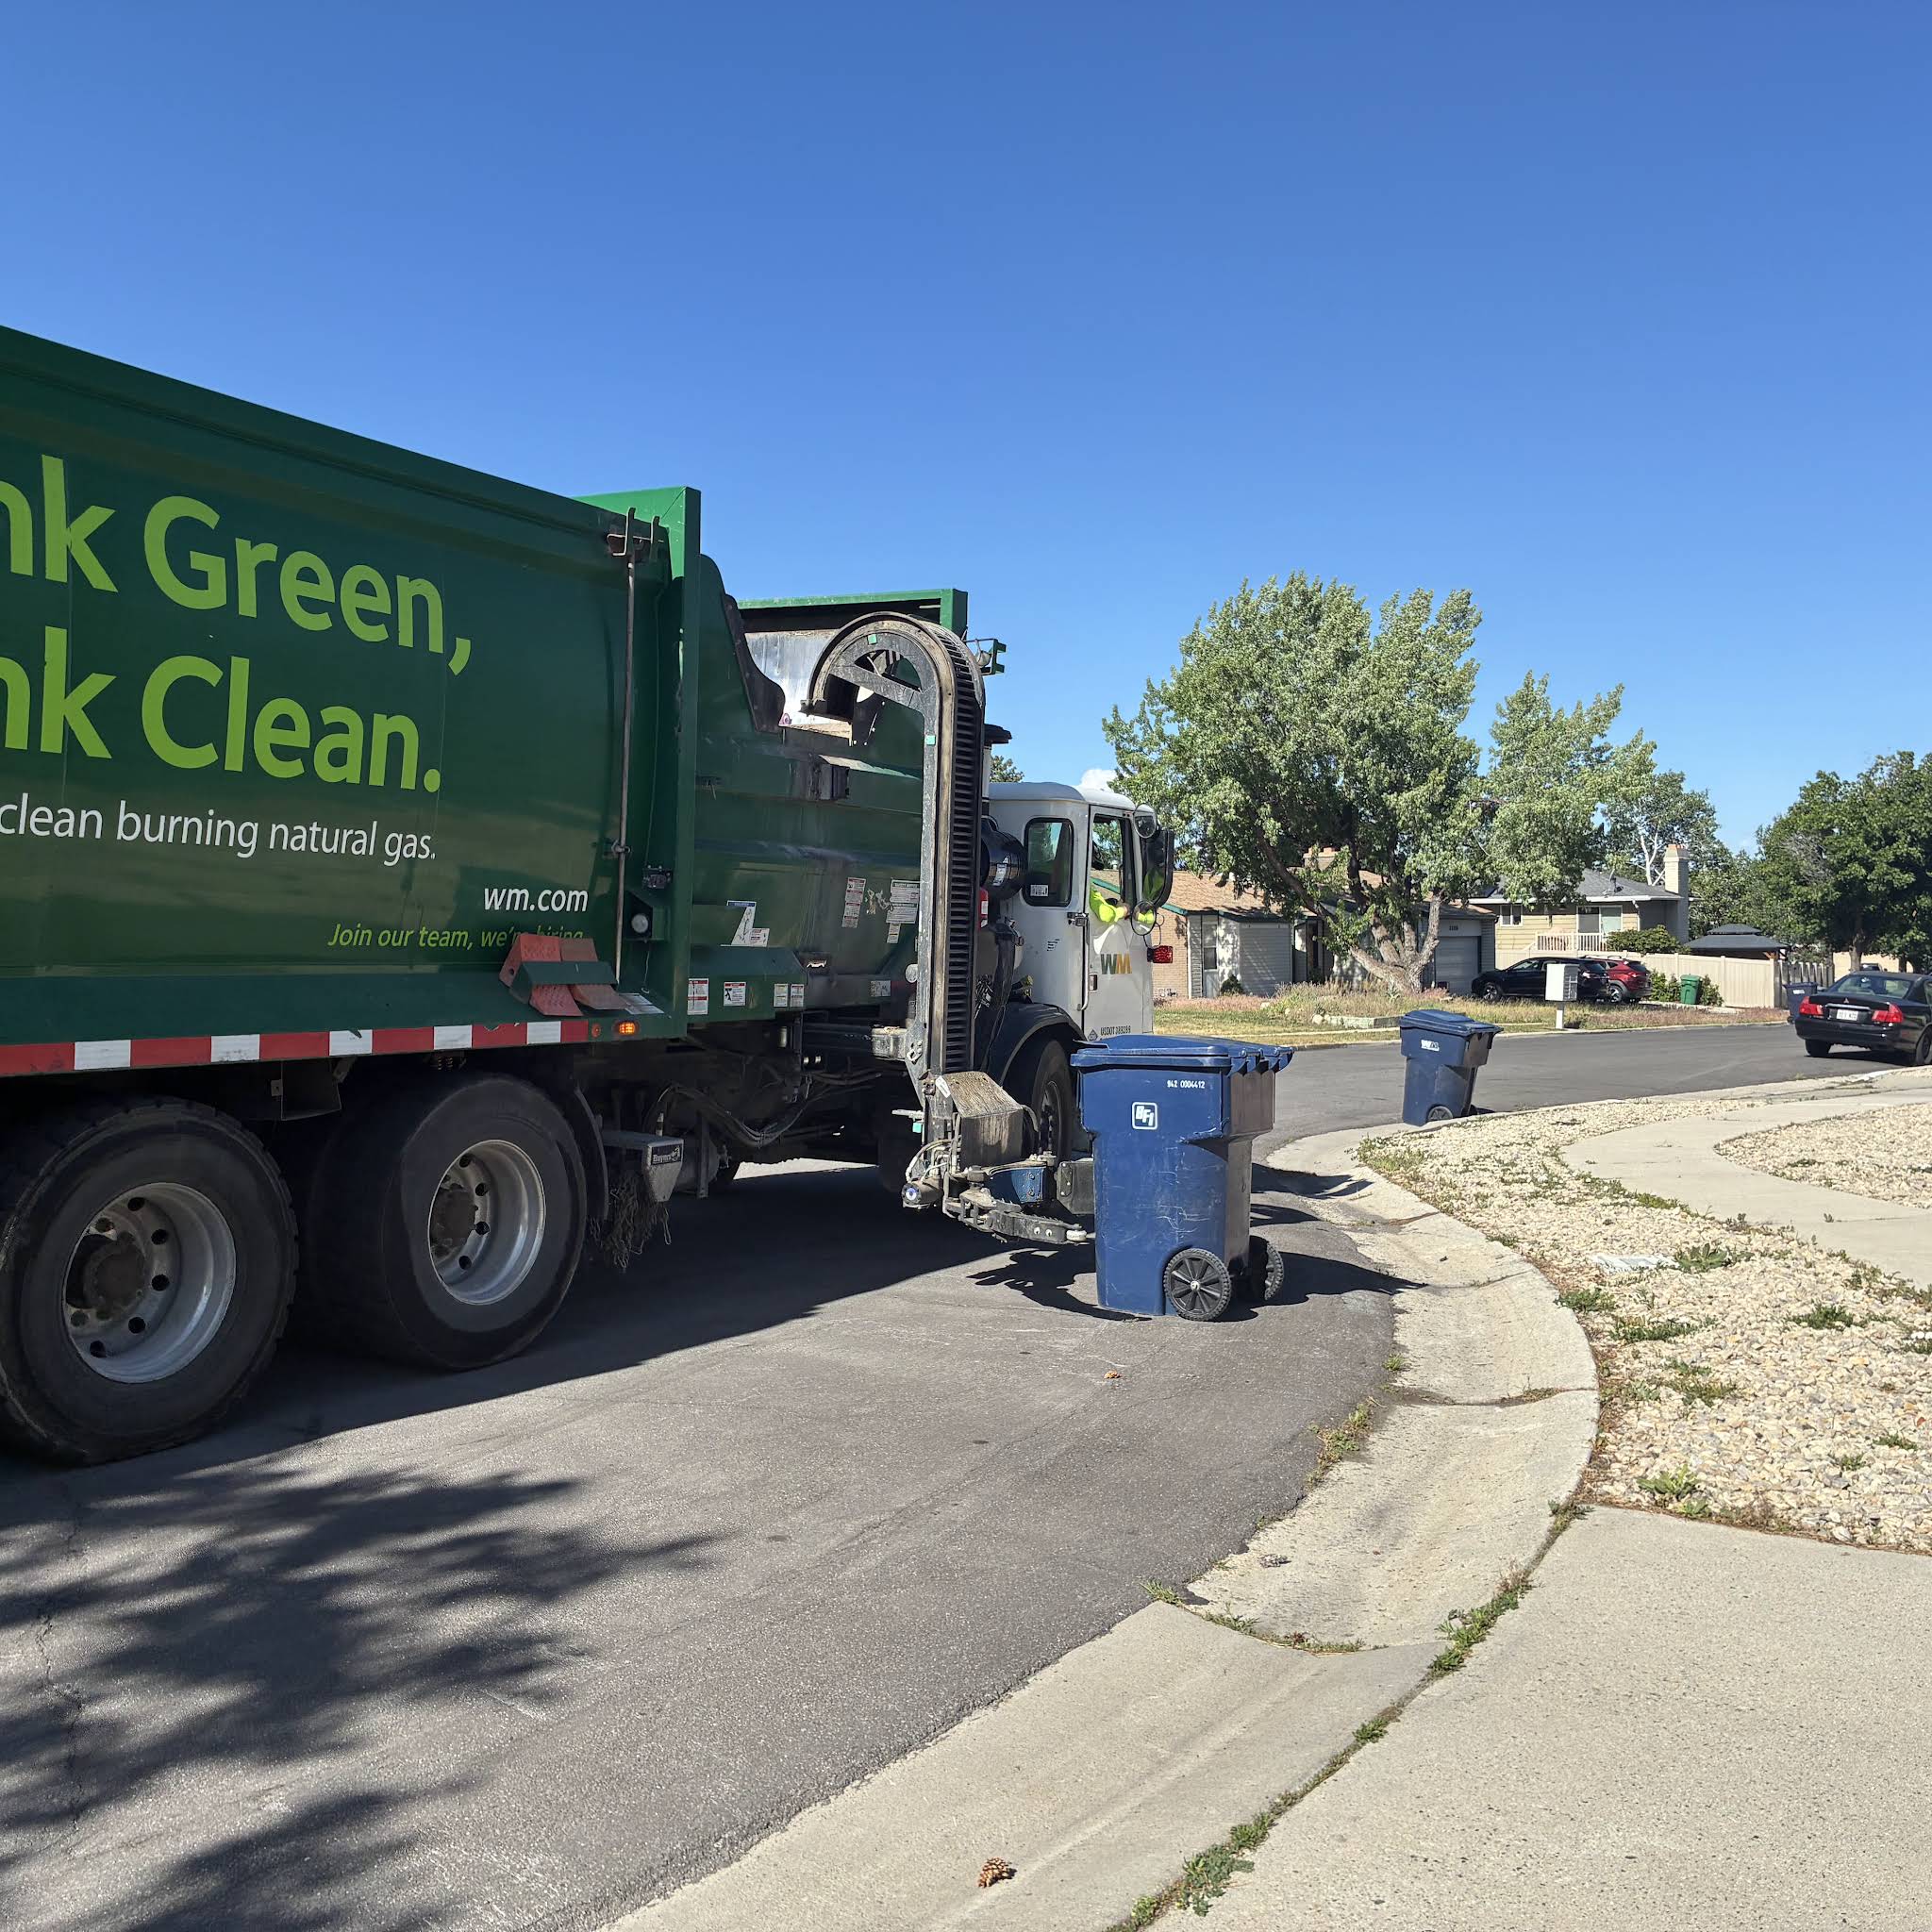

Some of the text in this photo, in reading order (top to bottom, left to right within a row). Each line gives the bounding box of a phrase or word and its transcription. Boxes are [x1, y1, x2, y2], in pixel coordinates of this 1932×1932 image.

[144, 496, 472, 675] Green,
[142, 656, 441, 792] Clean.
[0, 792, 437, 867] clean burning natural gas.
[484, 887, 589, 912] wm.com
[327, 923, 373, 947] Join
[377, 928, 415, 947] our
[418, 925, 473, 950] team,
[1100, 953, 1132, 974] WM
[1135, 1105, 1155, 1126] BFI
